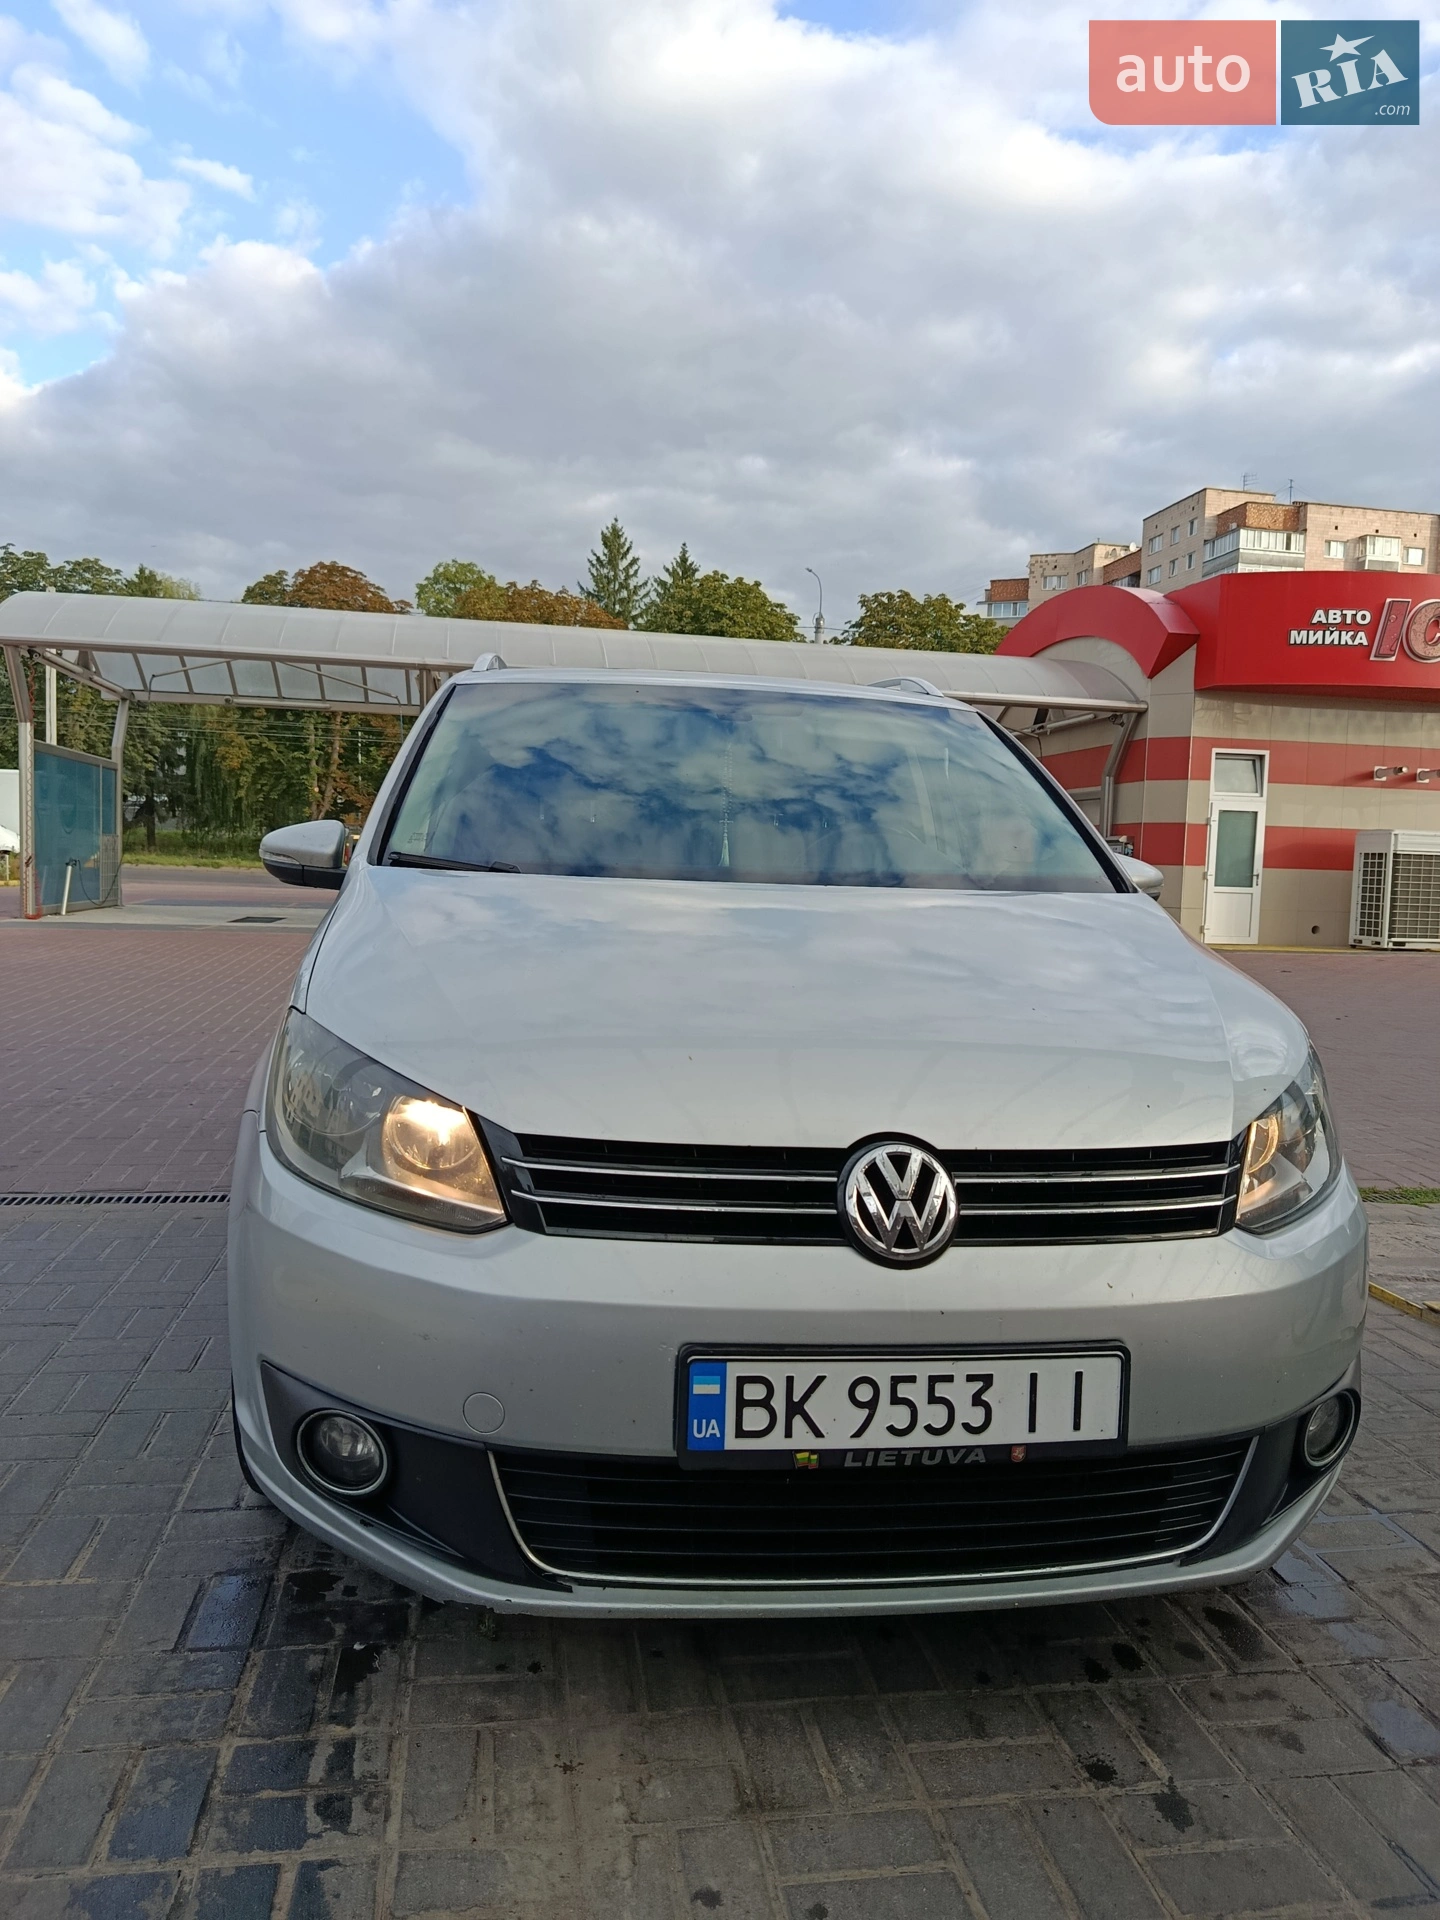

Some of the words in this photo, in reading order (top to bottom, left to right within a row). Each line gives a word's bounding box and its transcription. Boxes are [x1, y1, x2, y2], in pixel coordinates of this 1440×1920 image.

[1311, 609, 1372, 625] АВТО
[1289, 627, 1369, 646] МИЙКА
[734, 1374, 829, 1440] BK
[847, 1373, 995, 1439] 9553
[1027, 1370, 1085, 1433] II
[692, 1418, 721, 1439] UA
[843, 1447, 987, 1468] LIETUVA
